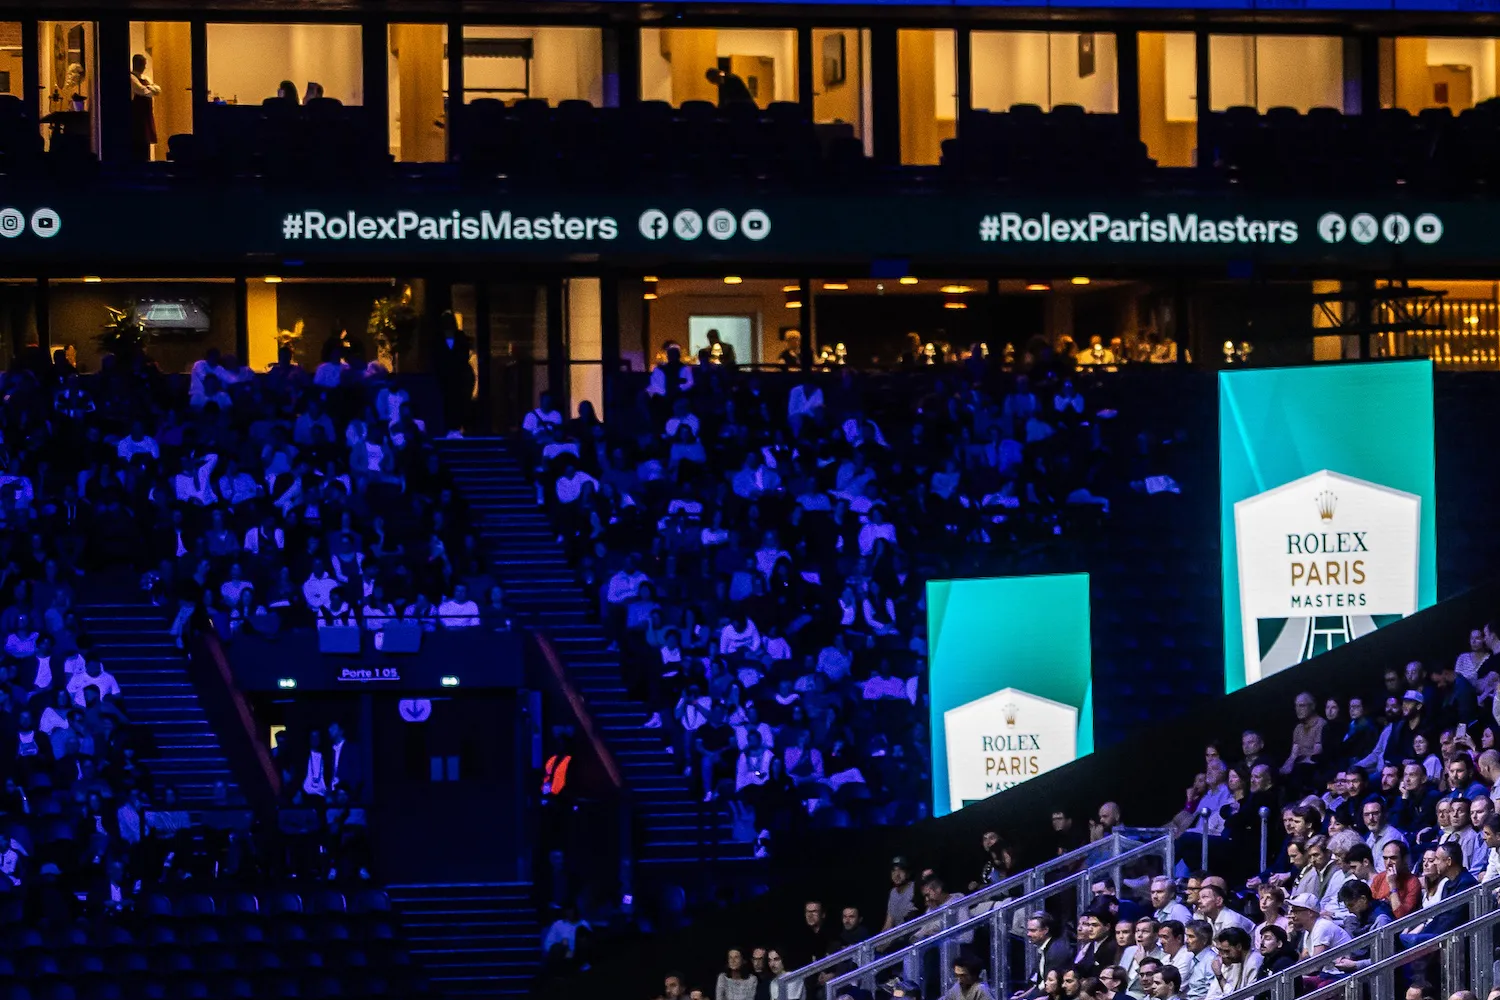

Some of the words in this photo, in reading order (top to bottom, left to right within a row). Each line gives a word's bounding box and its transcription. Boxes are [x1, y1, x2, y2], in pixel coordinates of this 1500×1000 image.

[282, 210, 618, 240] #RolexParisMasters
[980, 213, 1298, 243] #RolexParisMasters
[1286, 532, 1369, 554] ROLEX
[1291, 560, 1366, 586] PARIS
[1291, 593, 1367, 608] MASTERS
[341, 667, 372, 678] Porte
[982, 735, 1041, 752] ROLEX
[985, 756, 1039, 776] PARIS
